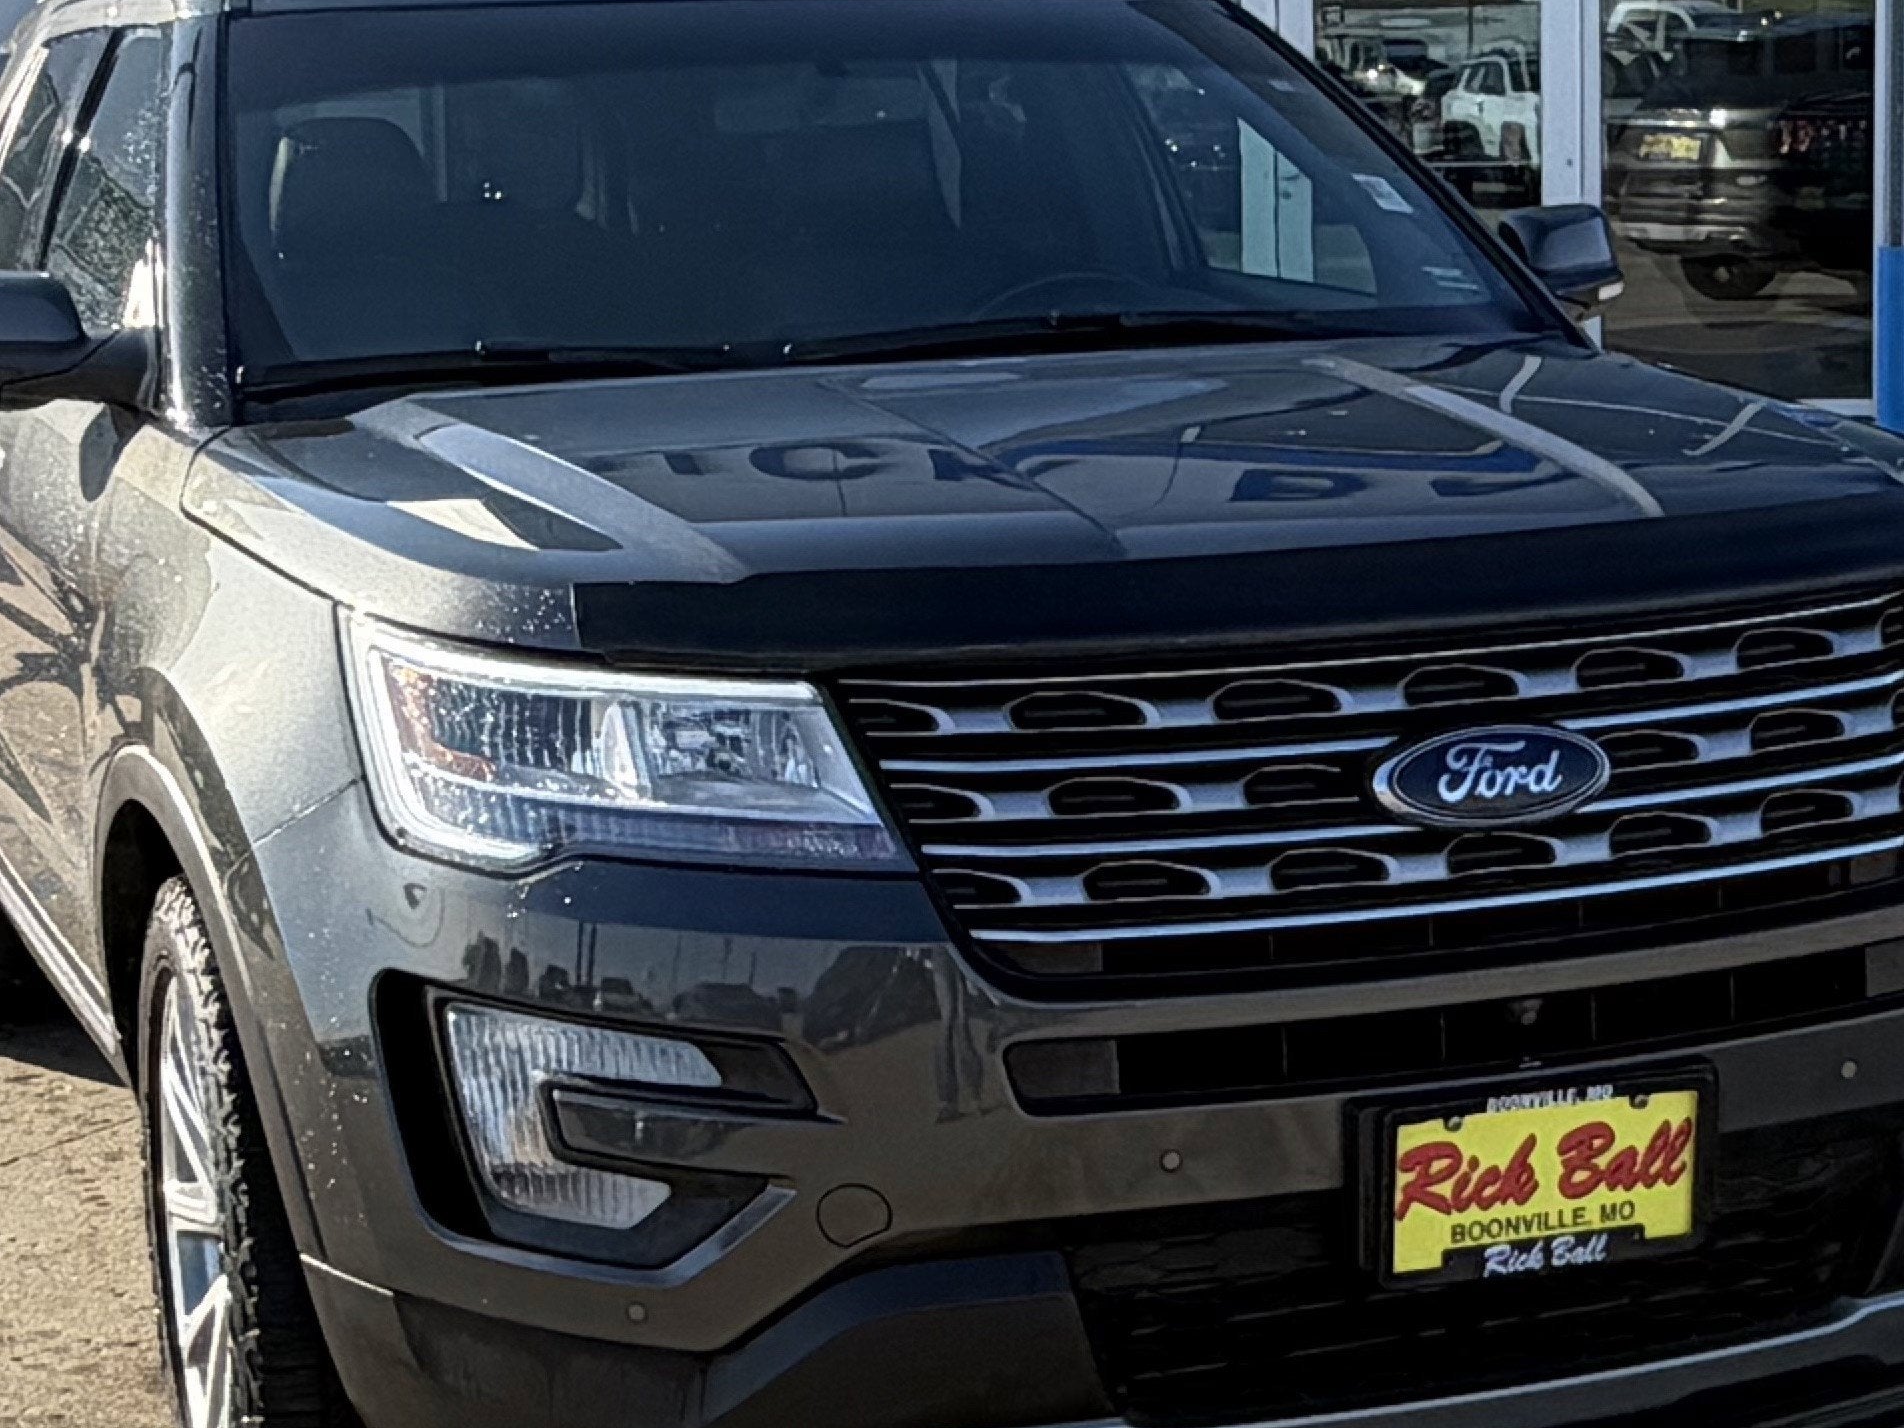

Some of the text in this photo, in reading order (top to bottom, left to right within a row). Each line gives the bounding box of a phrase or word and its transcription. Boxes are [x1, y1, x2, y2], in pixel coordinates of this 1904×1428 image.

[1438, 740, 1563, 803] Ford
[1393, 1117, 1692, 1222] Rick Ball
[1600, 1200, 1636, 1224] MO
[1483, 1234, 1609, 1278] Rick Ball
